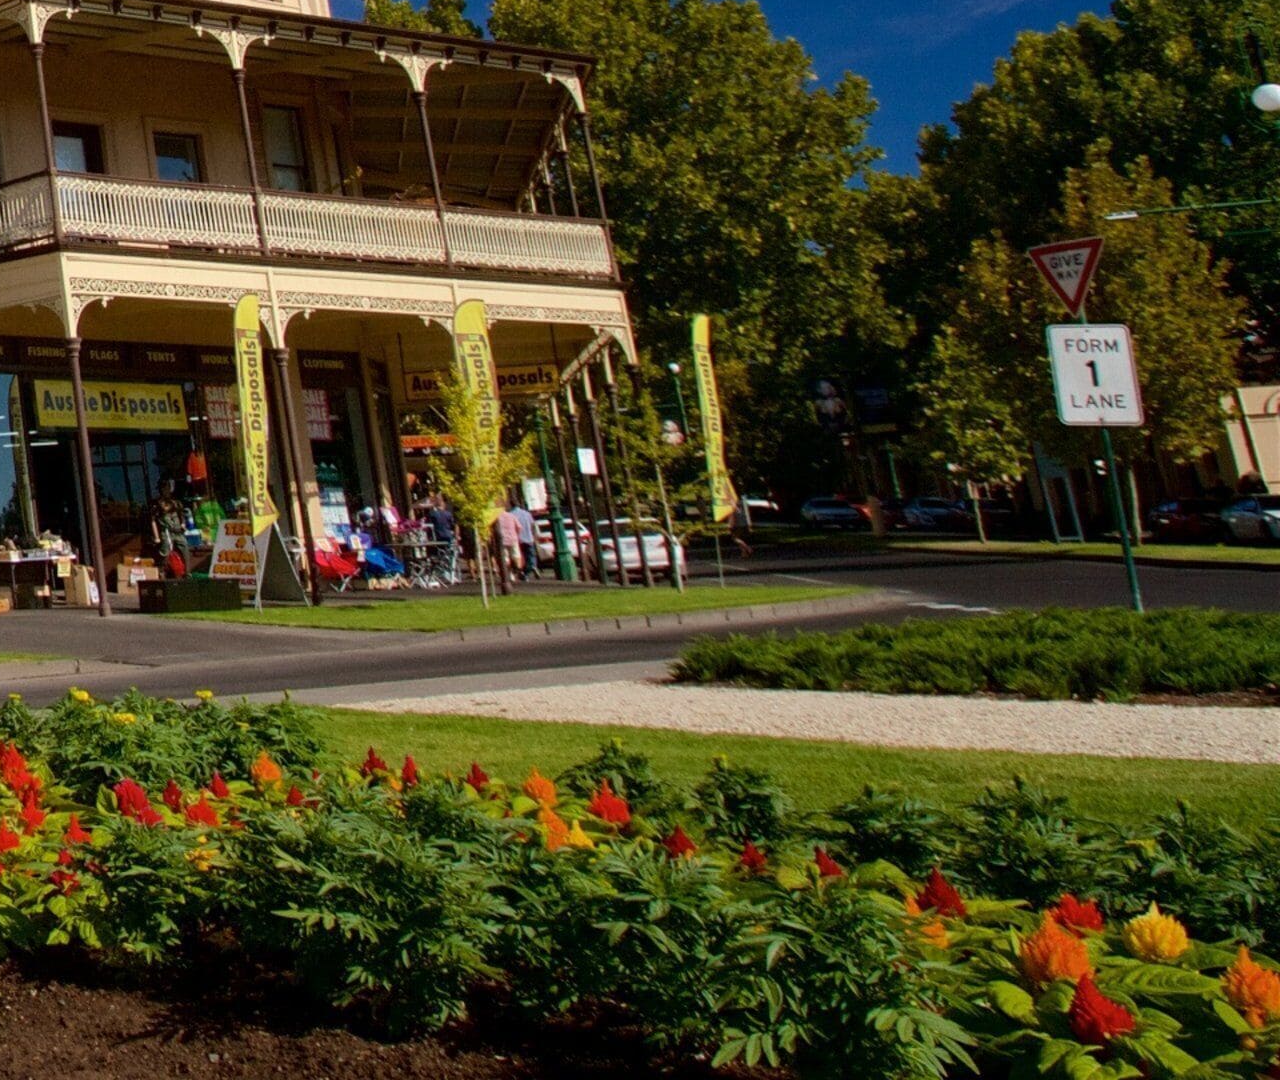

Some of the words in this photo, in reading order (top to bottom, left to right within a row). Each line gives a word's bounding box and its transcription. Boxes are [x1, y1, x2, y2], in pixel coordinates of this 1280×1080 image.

[1049, 253, 1083, 270] GIVE
[1056, 270, 1078, 281] WAY
[27, 347, 67, 358] FISHING
[1064, 339, 1119, 353] FORM
[90, 350, 120, 361] FLAGS
[146, 352, 176, 363] TENTS
[496, 367, 553, 387] posals
[1085, 360, 1100, 387] 1
[244, 340, 263, 431] Disposals
[467, 343, 493, 429] Disposals
[44, 390, 98, 413] Ausie
[100, 391, 181, 417] Disposals
[1071, 394, 1127, 409] LANE
[252, 443, 266, 504] Aussie
